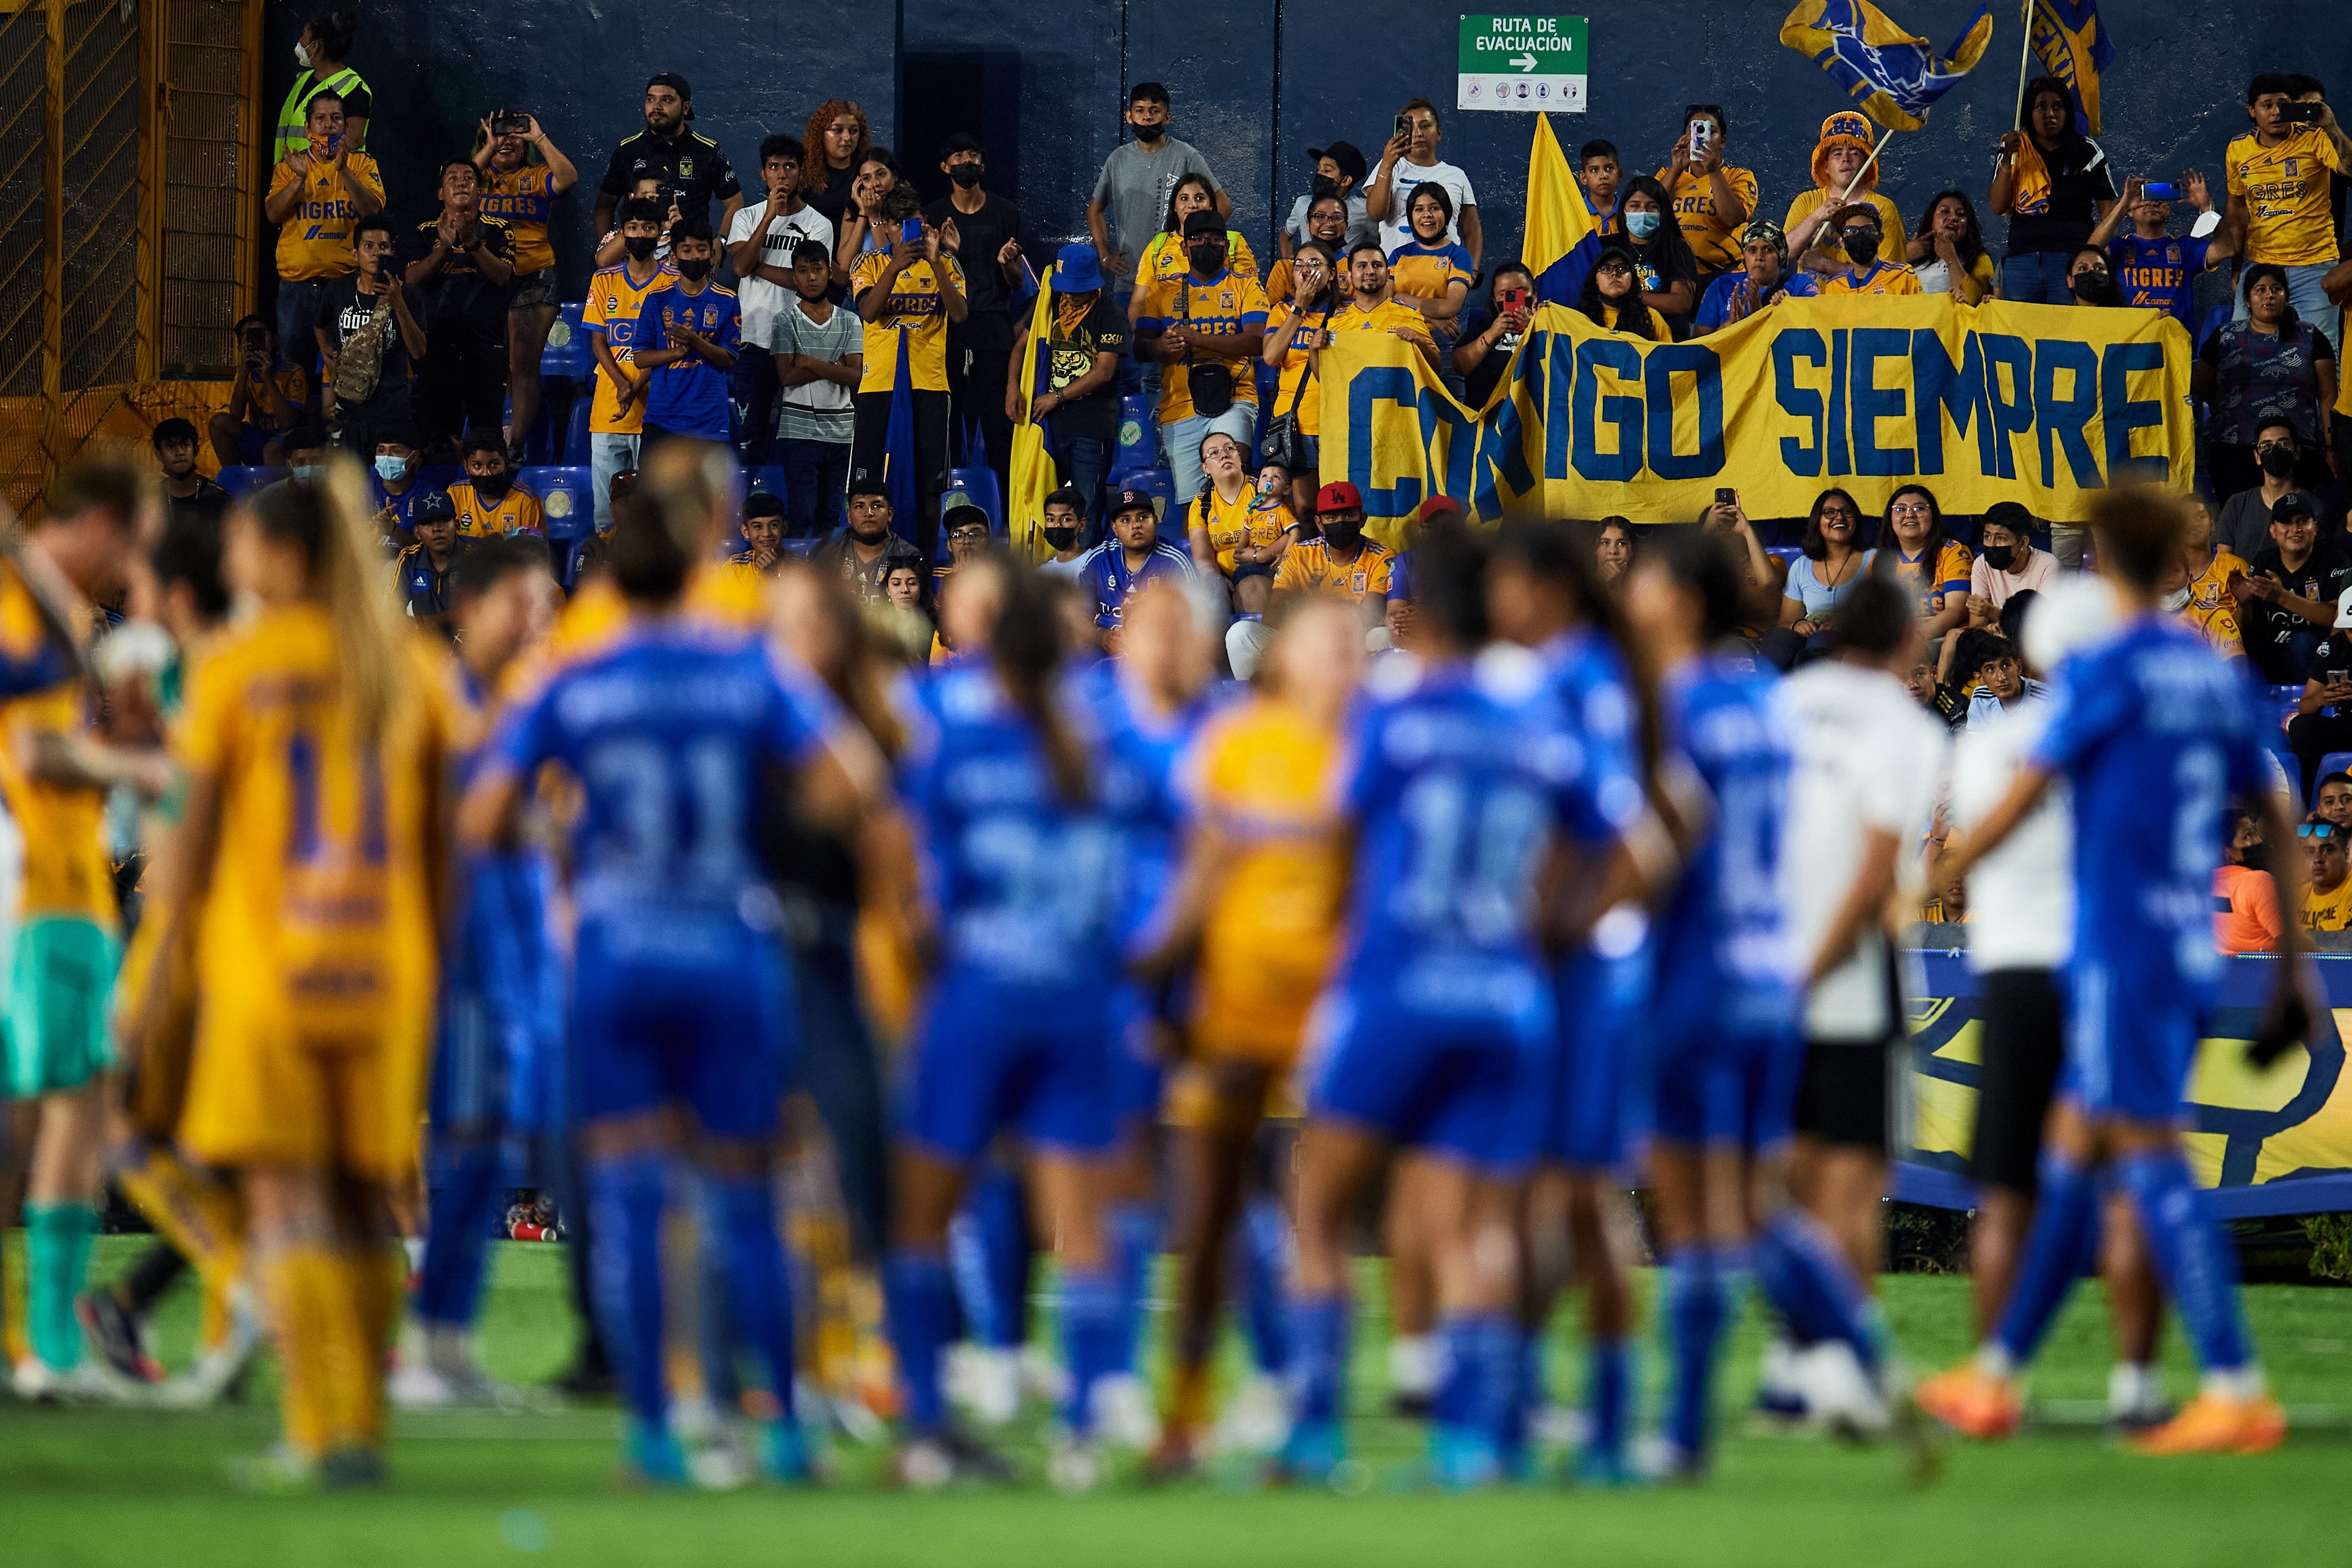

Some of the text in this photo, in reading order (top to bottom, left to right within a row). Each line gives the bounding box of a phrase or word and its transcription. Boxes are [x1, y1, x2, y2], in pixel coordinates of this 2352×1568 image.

[1492, 18, 1557, 33] RUTA DE
[1476, 33, 1572, 51] EVACUACIÓN
[295, 200, 358, 221] TIGRES
[479, 197, 536, 214] IGRES
[762, 233, 802, 250] UMA
[2123, 266, 2184, 287] TIGRES
[1770, 327, 2170, 489] SIEMPRE
[1331, 488, 1345, 504] LA
